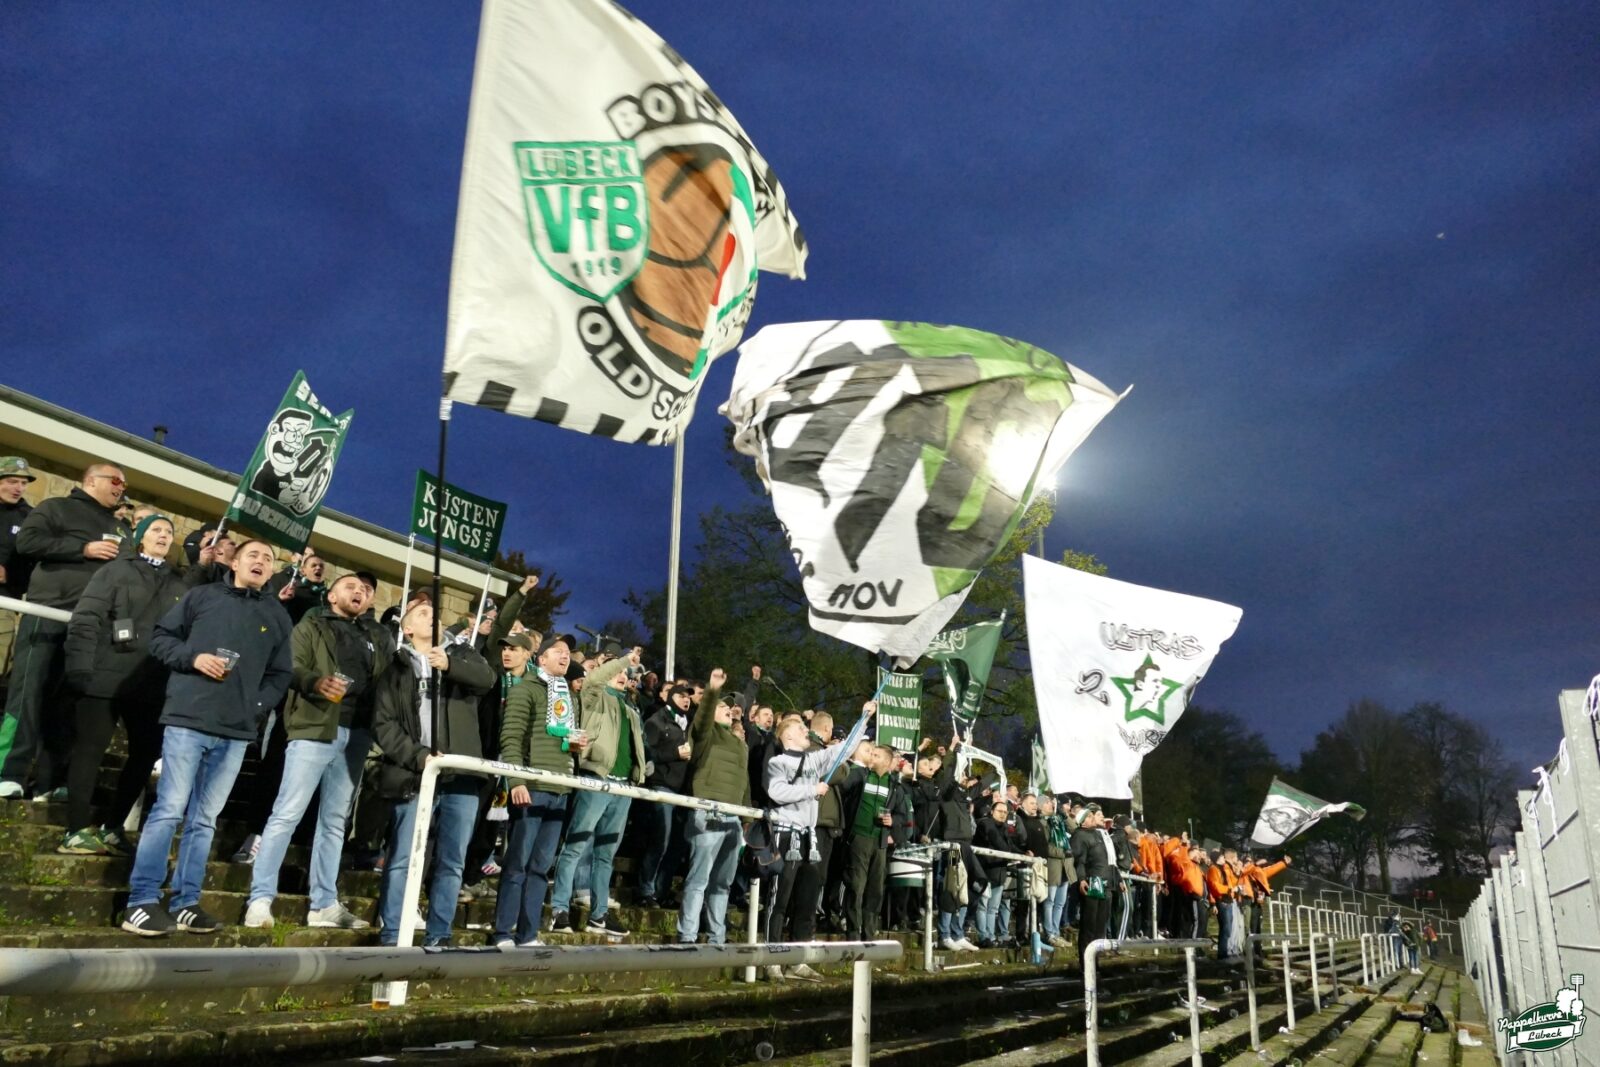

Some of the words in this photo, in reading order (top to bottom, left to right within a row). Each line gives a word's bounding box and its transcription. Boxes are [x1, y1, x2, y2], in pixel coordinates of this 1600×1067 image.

[533, 184, 642, 254] VfB
[570, 256, 623, 279] 1919
[578, 307, 652, 398] OLD
[418, 507, 482, 549] JUNGS
